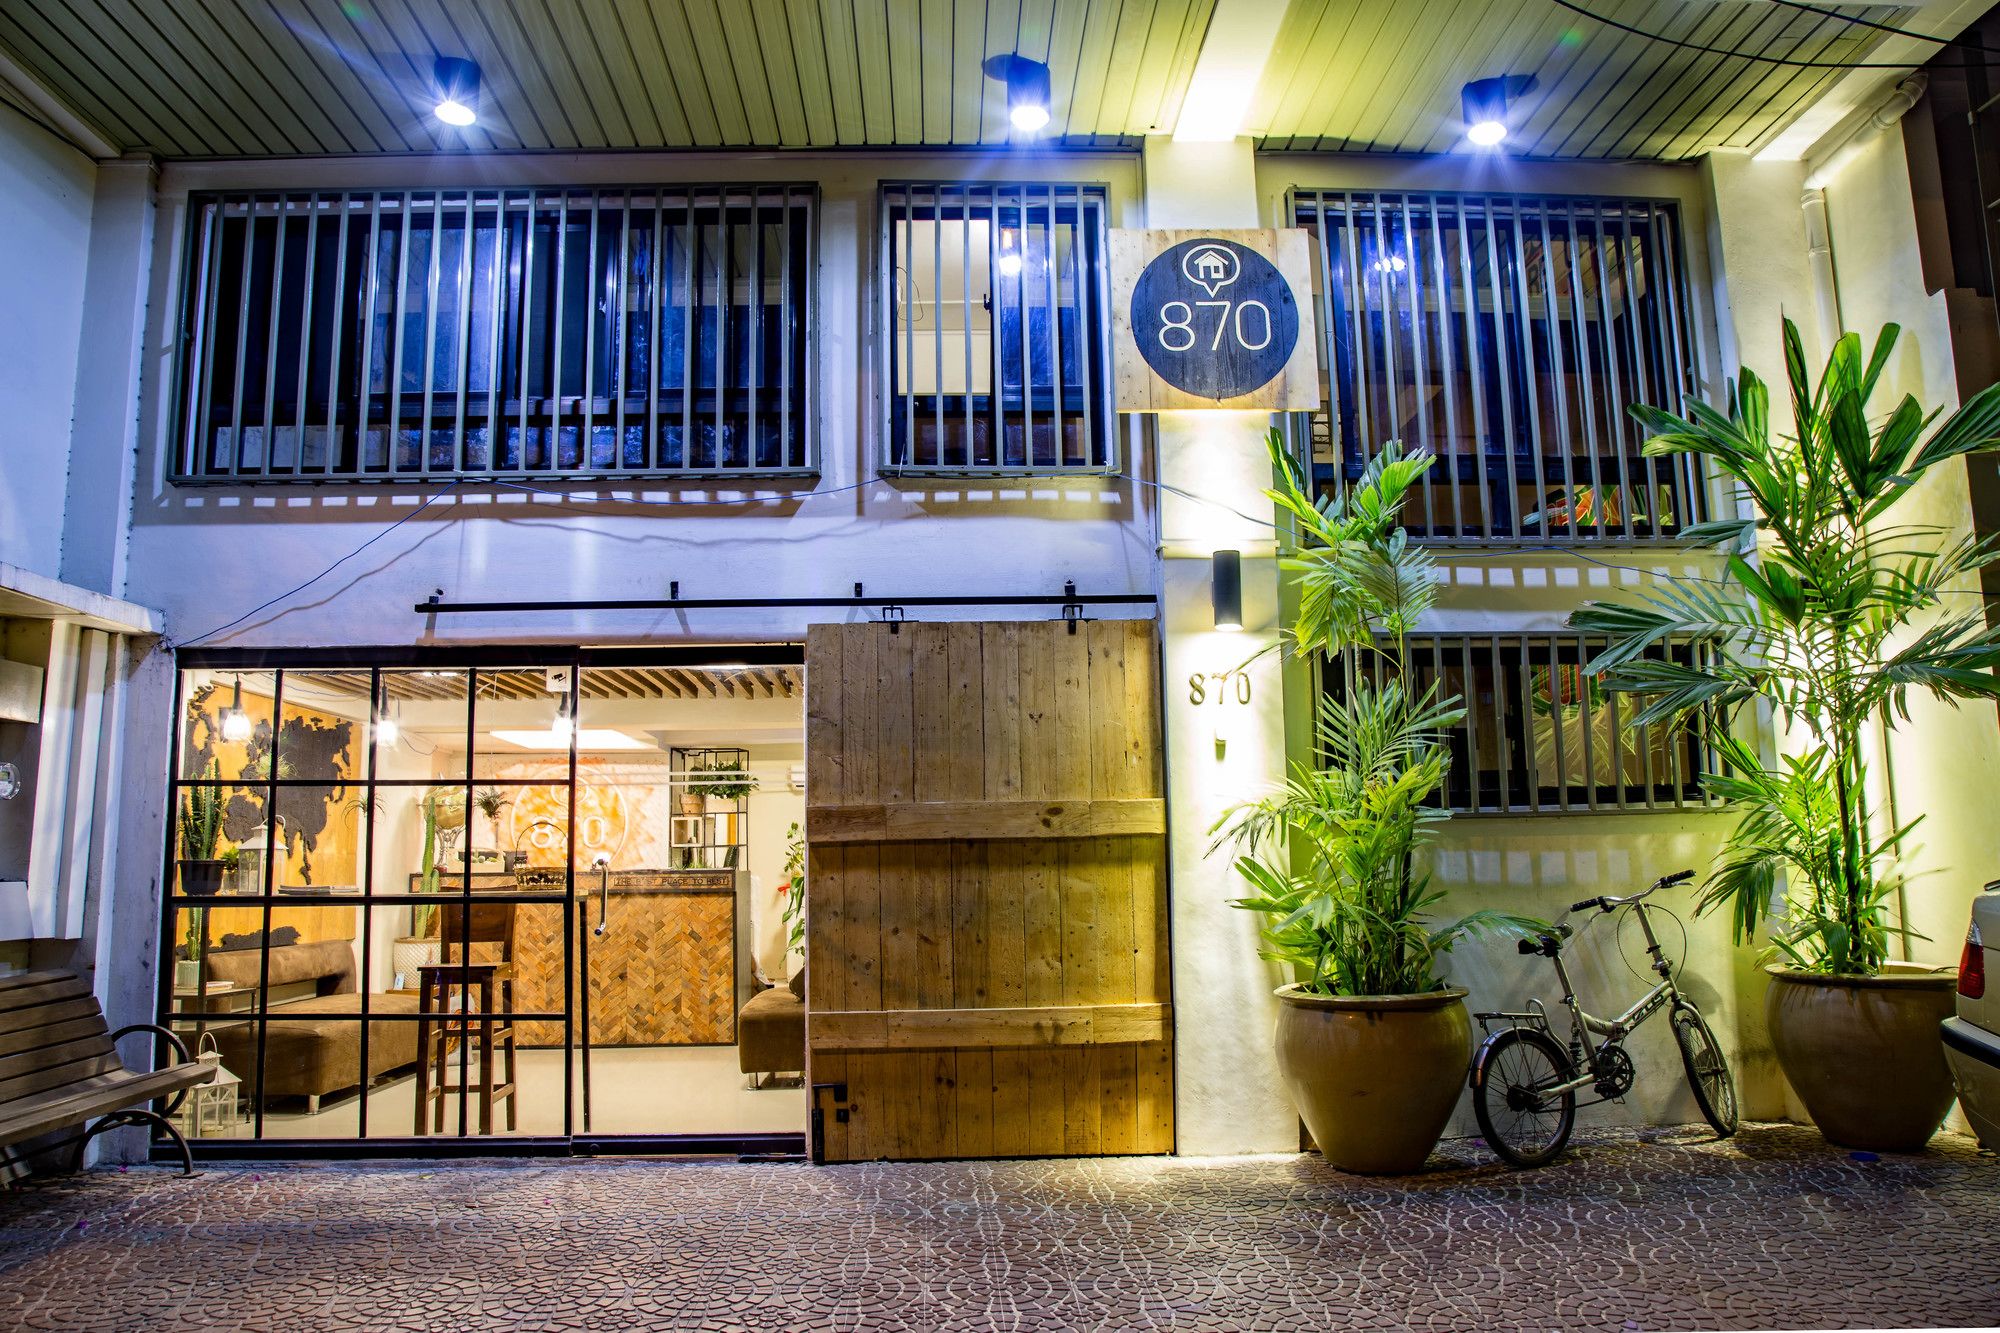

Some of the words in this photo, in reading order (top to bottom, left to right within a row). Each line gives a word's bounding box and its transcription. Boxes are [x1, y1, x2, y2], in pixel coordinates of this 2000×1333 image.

[1159, 300, 1272, 351] 870
[1188, 671, 1251, 706] 870
[615, 877, 631, 886] THE
[661, 877, 689, 886] PLACE
[693, 877, 704, 886] TO
